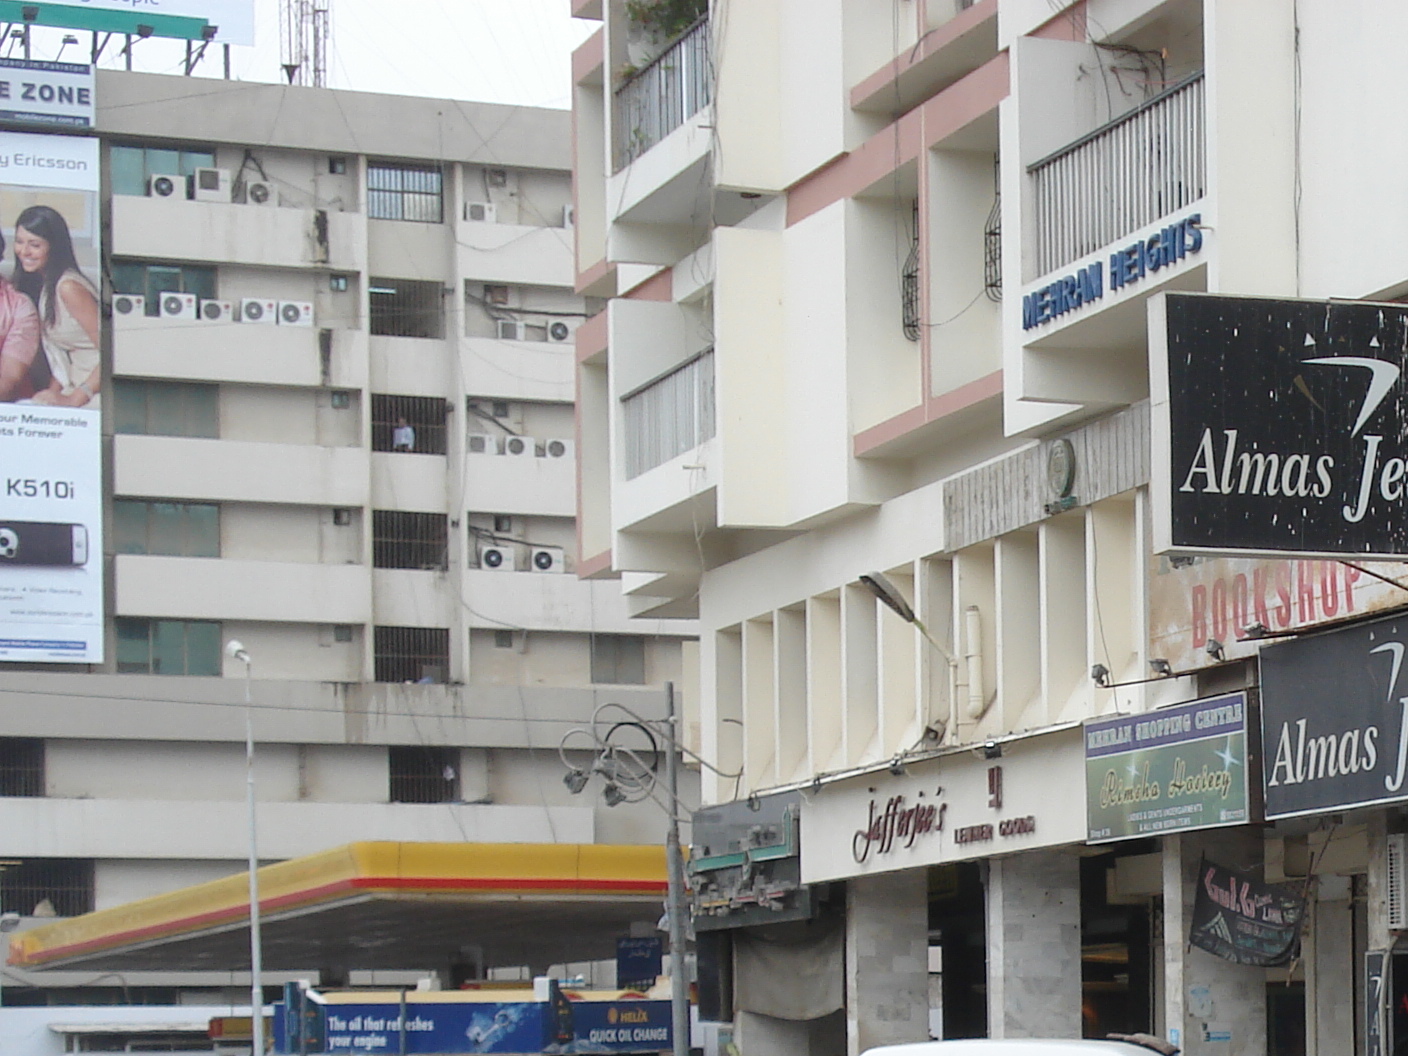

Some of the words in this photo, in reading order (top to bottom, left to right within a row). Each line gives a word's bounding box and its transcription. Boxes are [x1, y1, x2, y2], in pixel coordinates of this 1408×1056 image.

[21, 82, 91, 105] ZONE
[13, 153, 87, 171] Ericsson
[1022, 261, 1103, 330] MEHRAN
[1110, 213, 1203, 291] HEIGHTS
[21, 414, 88, 428] Memorable
[18, 427, 63, 439] Forever
[1179, 428, 1334, 498] Almas
[7, 478, 74, 499] K510i
[1193, 560, 1361, 648] BOOKSHOP
[1088, 725, 1132, 749] MEHRAN
[1136, 714, 1191, 741] SHOPPING
[1195, 704, 1242, 729] CENTRE
[1268, 718, 1378, 786] Almas
[1169, 757, 1231, 799] Hosiery
[328, 1016, 346, 1031] The
[349, 1016, 361, 1031] oil
[364, 1016, 384, 1031] that
[387, 1015, 434, 1031] refeshes
[328, 1037, 350, 1050] your
[354, 1033, 386, 1050] engine
[590, 1029, 616, 1042] QUICK
[618, 1029, 632, 1042] OIL
[634, 1028, 667, 1042] CHANGE
